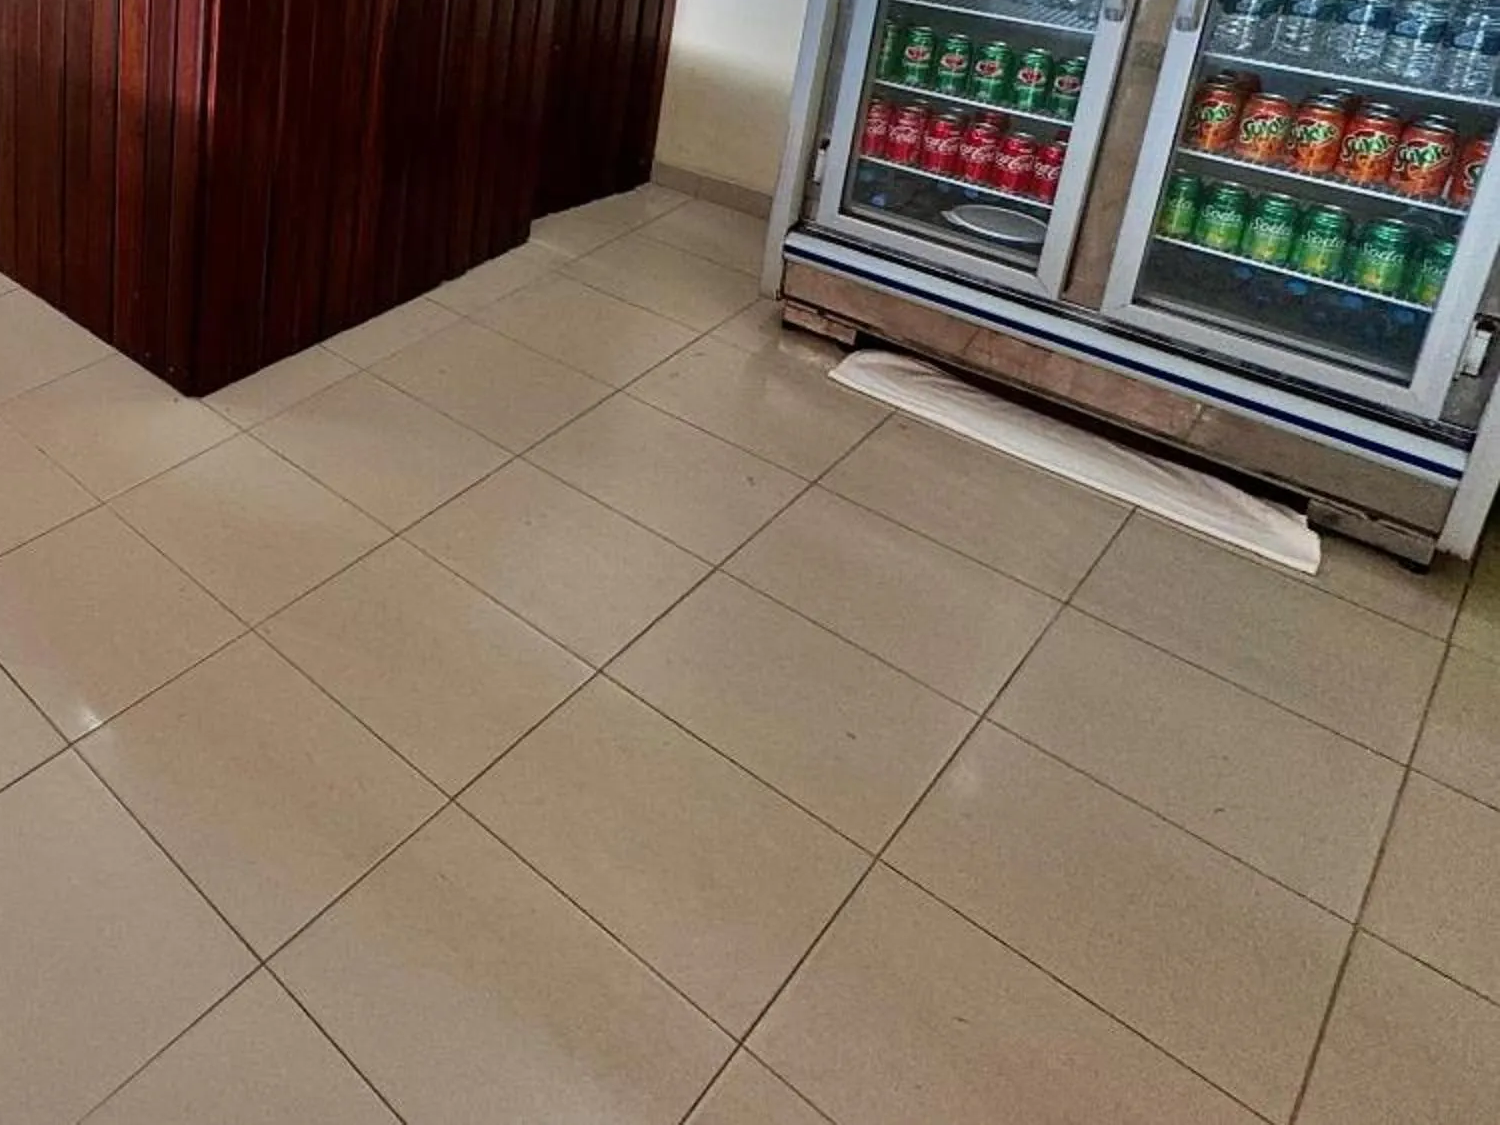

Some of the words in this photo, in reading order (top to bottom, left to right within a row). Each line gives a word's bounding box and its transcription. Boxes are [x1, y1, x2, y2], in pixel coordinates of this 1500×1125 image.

[1201, 205, 1242, 223] Soda
[1250, 216, 1294, 236] Soda
[1300, 230, 1346, 248] Soda
[1360, 243, 1405, 263] Soda
